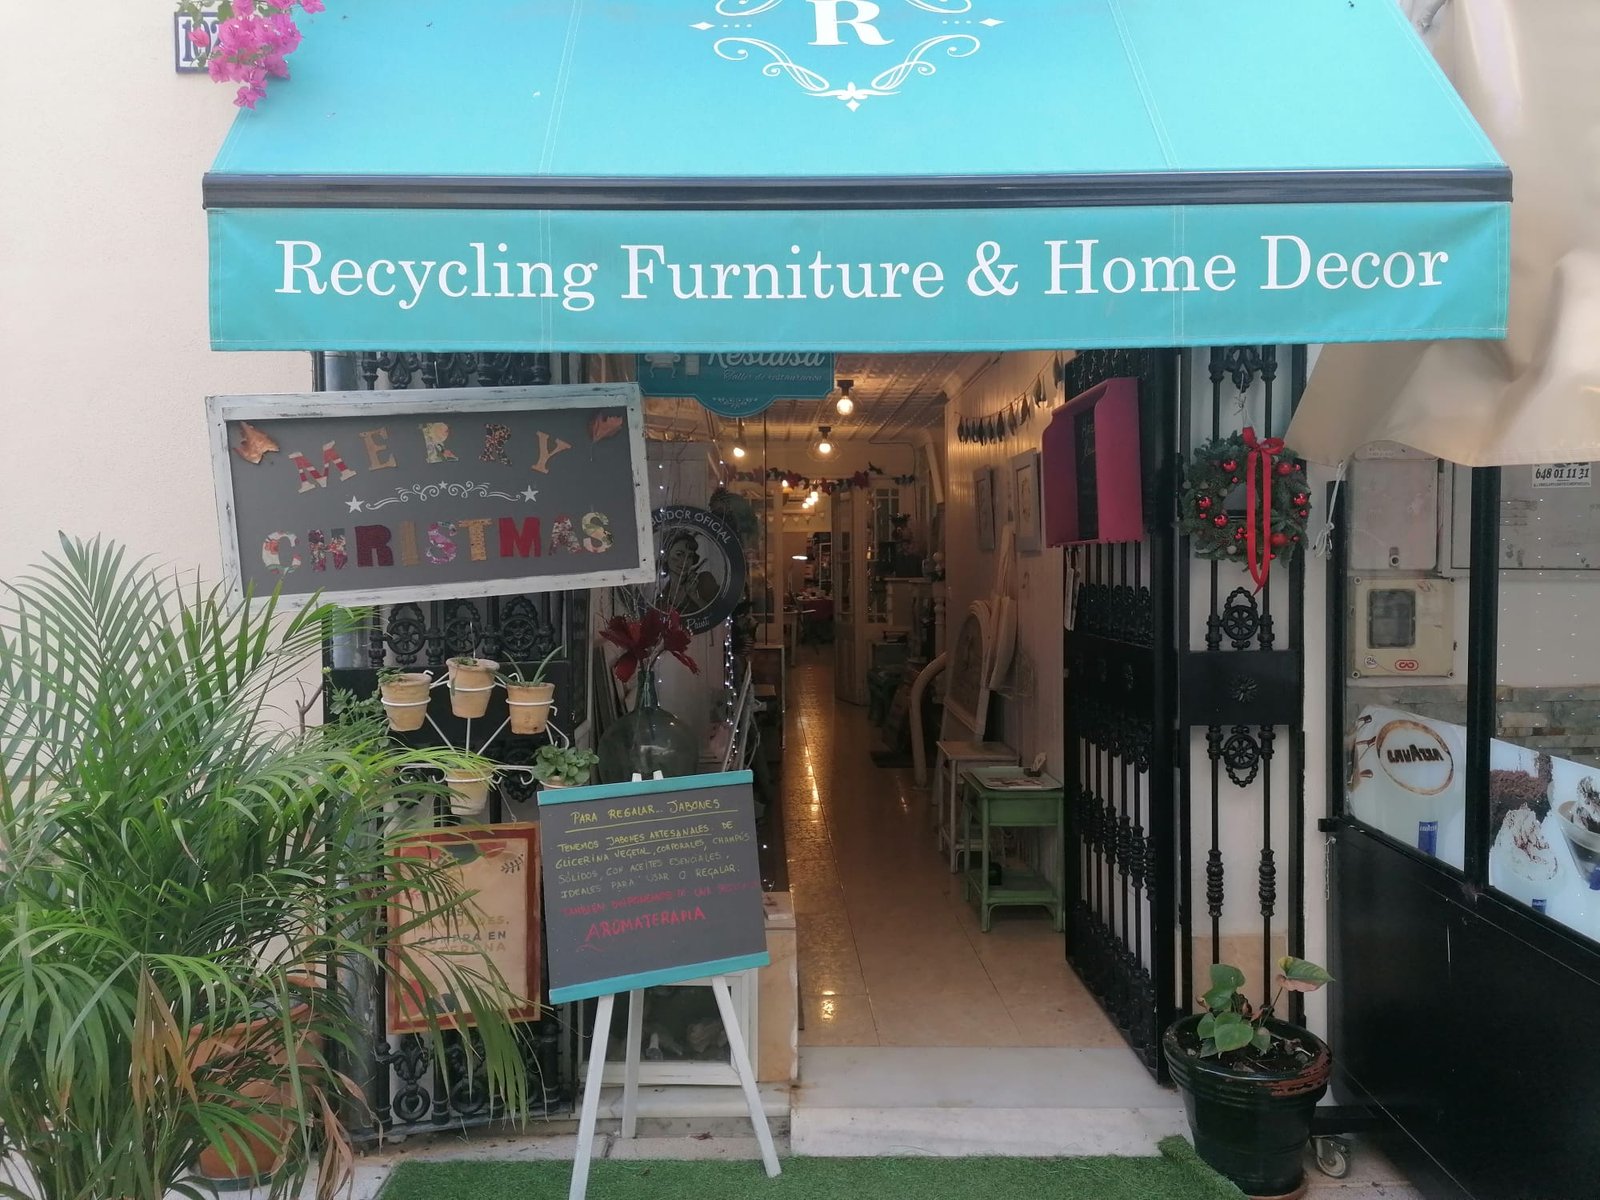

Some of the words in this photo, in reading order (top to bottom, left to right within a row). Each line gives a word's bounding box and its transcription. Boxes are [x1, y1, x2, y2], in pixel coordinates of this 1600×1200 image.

[807, 0, 895, 46] R
[275, 240, 599, 312] Recycling
[621, 244, 945, 300] Furniture
[967, 241, 1019, 297] &
[1045, 239, 1237, 295] Home
[1261, 234, 1449, 290] Decor
[288, 422, 573, 494] MERRY
[1535, 468, 1552, 480] 648
[1554, 468, 1565, 479] 01
[1566, 468, 1577, 479] 11
[261, 511, 614, 575] CHRISTMAS
[694, 512, 732, 544] OFICIAL
[570, 810, 598, 825] PARA
[666, 798, 721, 815] JABONES
[557, 840, 600, 853] TENEMOS
[606, 833, 646, 847] JABONES
[649, 824, 710, 841] ARTESANALES
[722, 820, 734, 830] DE
[555, 853, 609, 870] GLICERINA
[606, 864, 624, 876] CON
[629, 859, 663, 873] ACEITES
[561, 884, 601, 899] IDEALES
[611, 879, 634, 890] PARA
[488, 930, 507, 940] EN
[584, 906, 707, 942] AROMATERAPIA
